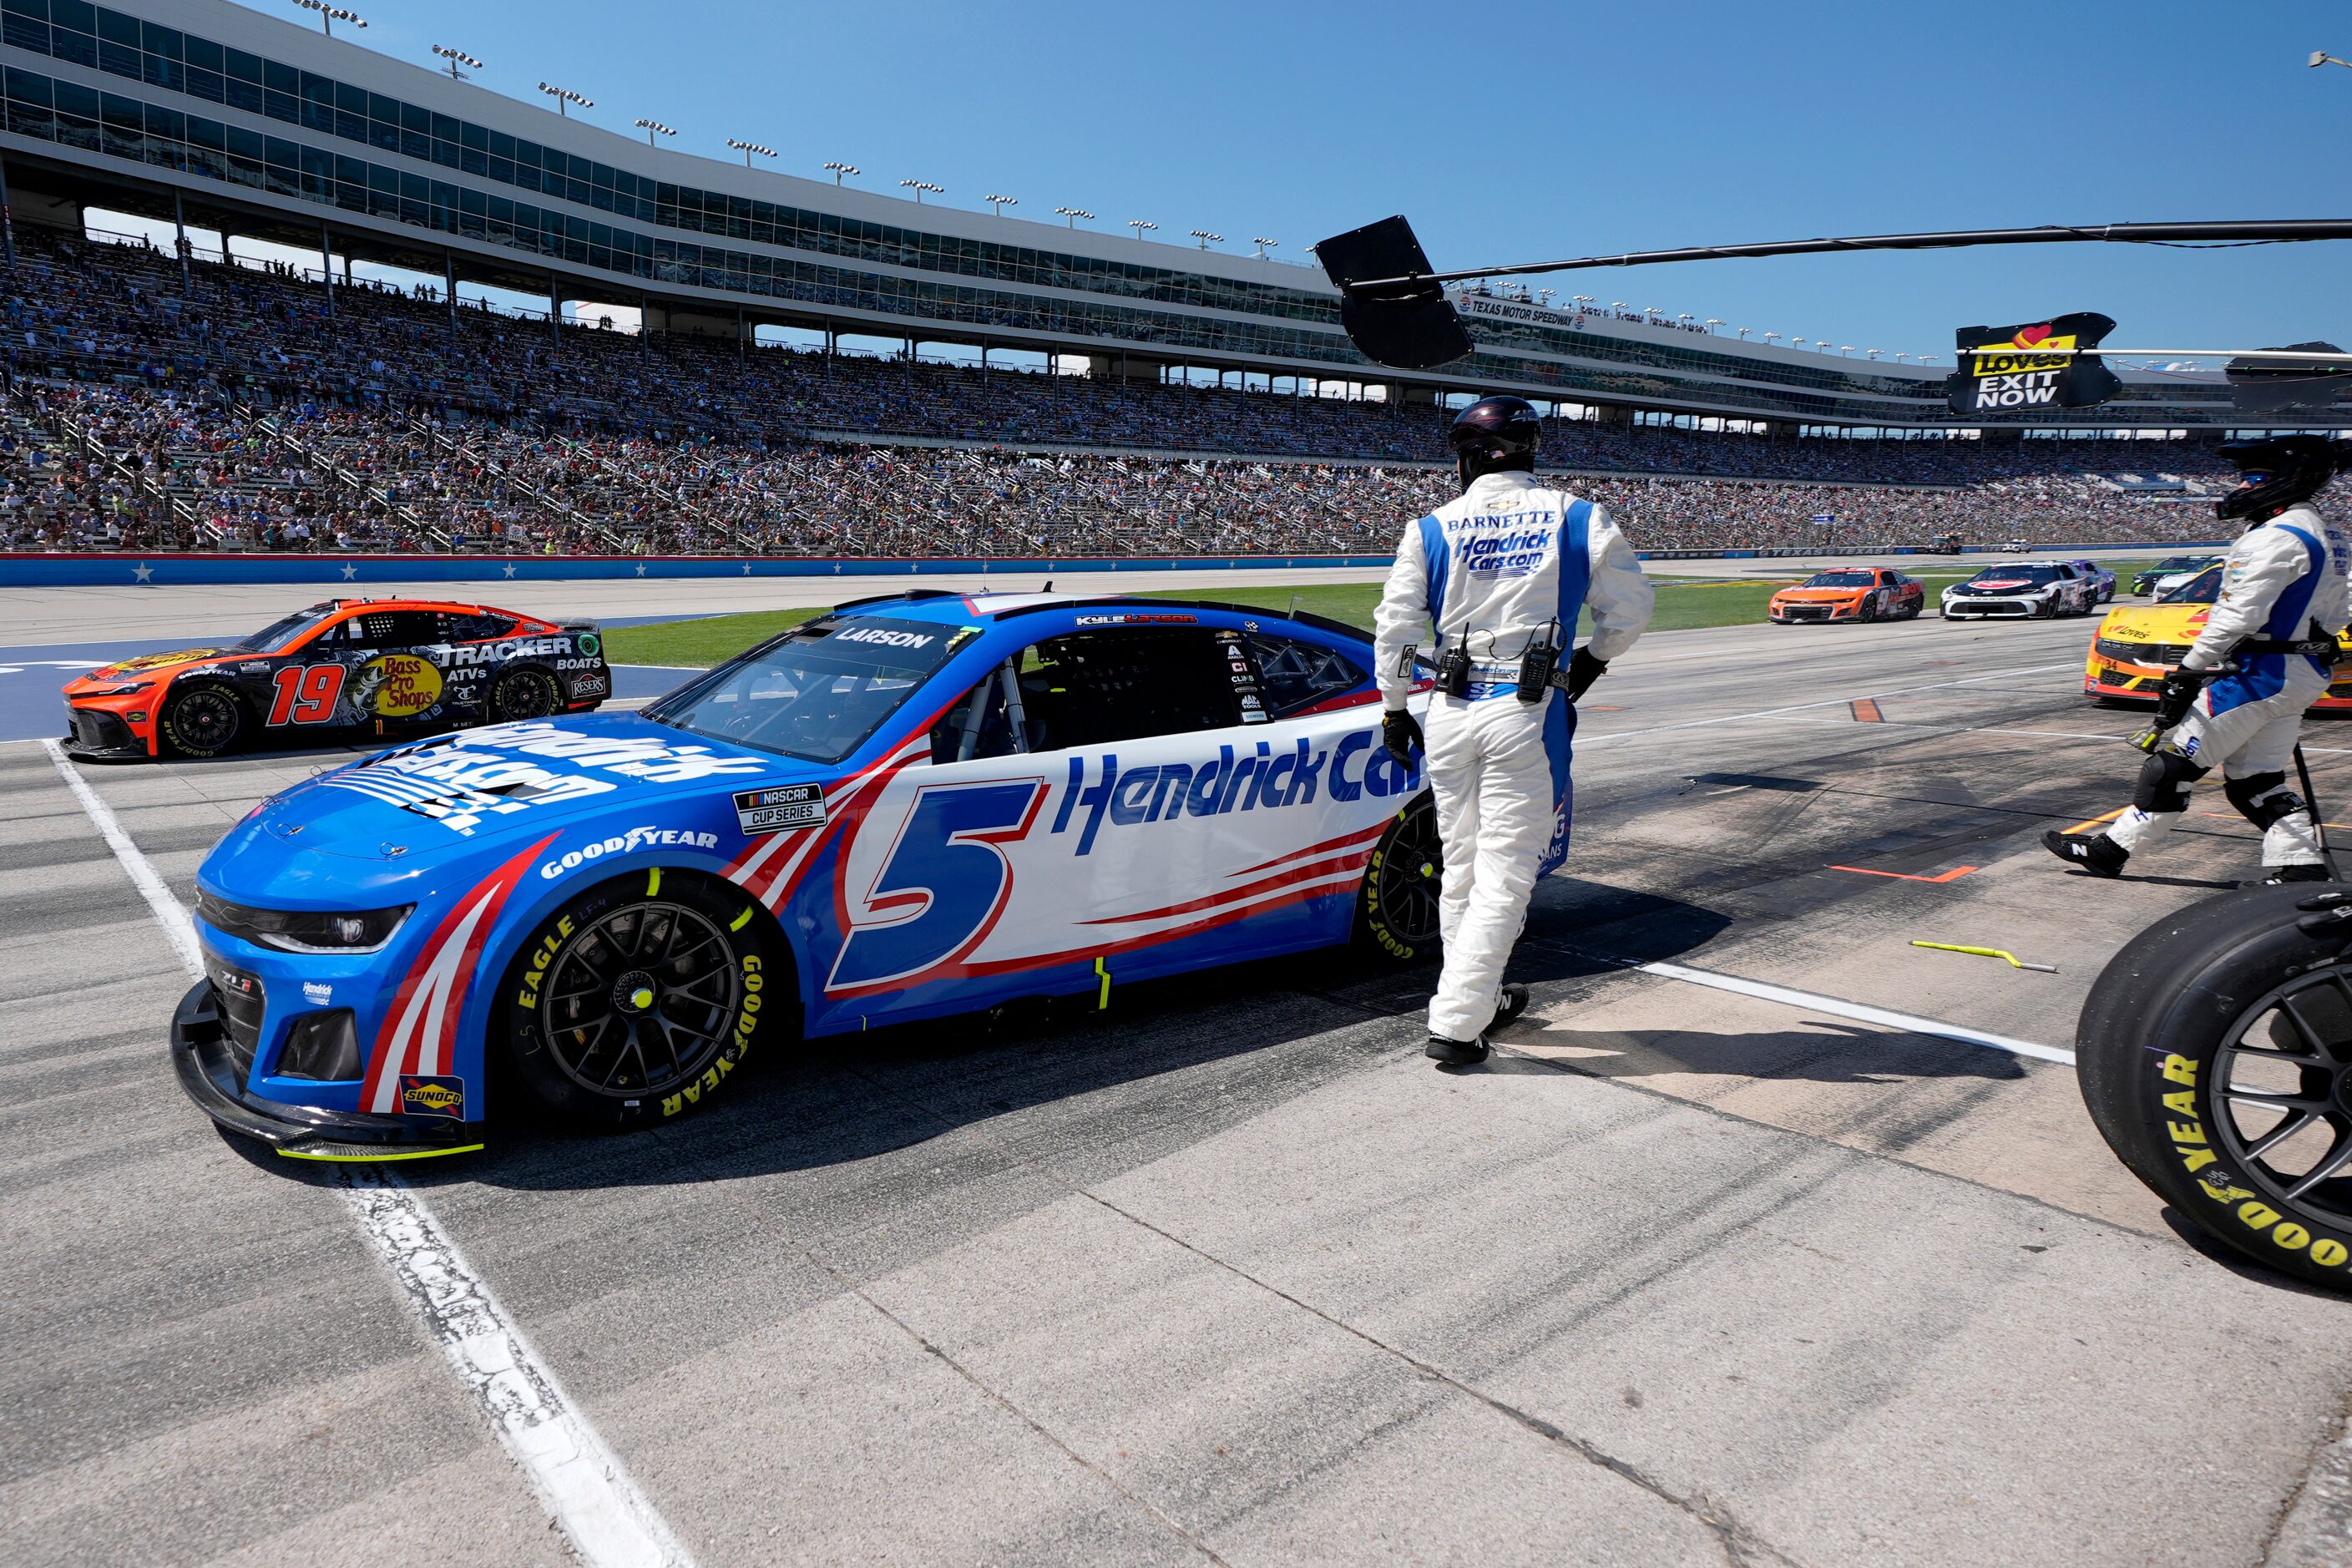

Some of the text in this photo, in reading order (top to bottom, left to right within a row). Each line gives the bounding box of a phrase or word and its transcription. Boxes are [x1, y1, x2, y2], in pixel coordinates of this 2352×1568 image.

[1473, 301, 1574, 326] TEXAS MOTOR SPEEDWAY
[1979, 370, 2061, 393] EXIT
[1975, 387, 2058, 409] NOW
[1447, 510, 1556, 532] BARNETTE
[1455, 529, 1551, 563] Hendrick
[1773, 549, 1823, 557] TEXAS
[1469, 551, 1544, 571] Cars.com
[1879, 590, 1890, 610] 9
[835, 627, 933, 649] LARSON
[435, 637, 572, 667] TRACKER
[384, 658, 422, 675] Bass
[557, 657, 601, 670] BOATS
[2105, 659, 2117, 670] 34
[178, 669, 236, 680] GOODYEAR
[387, 674, 414, 691] Pro
[447, 668, 487, 682] ATVs
[211, 684, 240, 702] EAGLE
[266, 663, 347, 728] 19
[387, 690, 434, 710] Shops
[495, 680, 503, 706] EAGLE
[763, 787, 809, 806] NASCAR
[752, 806, 813, 823] CUP SERIES
[540, 826, 718, 880] GOODYEAR
[2071, 843, 2088, 857] N
[825, 777, 1050, 998] 5
[1368, 850, 1414, 959] GOODYEAR
[518, 913, 576, 1009] EAGLE
[302, 981, 332, 995] Hendrick
[661, 954, 764, 1117] GOODYEAR
[405, 1089, 463, 1106] SUNOCO
[2162, 1054, 2352, 1267] OODYEAR
